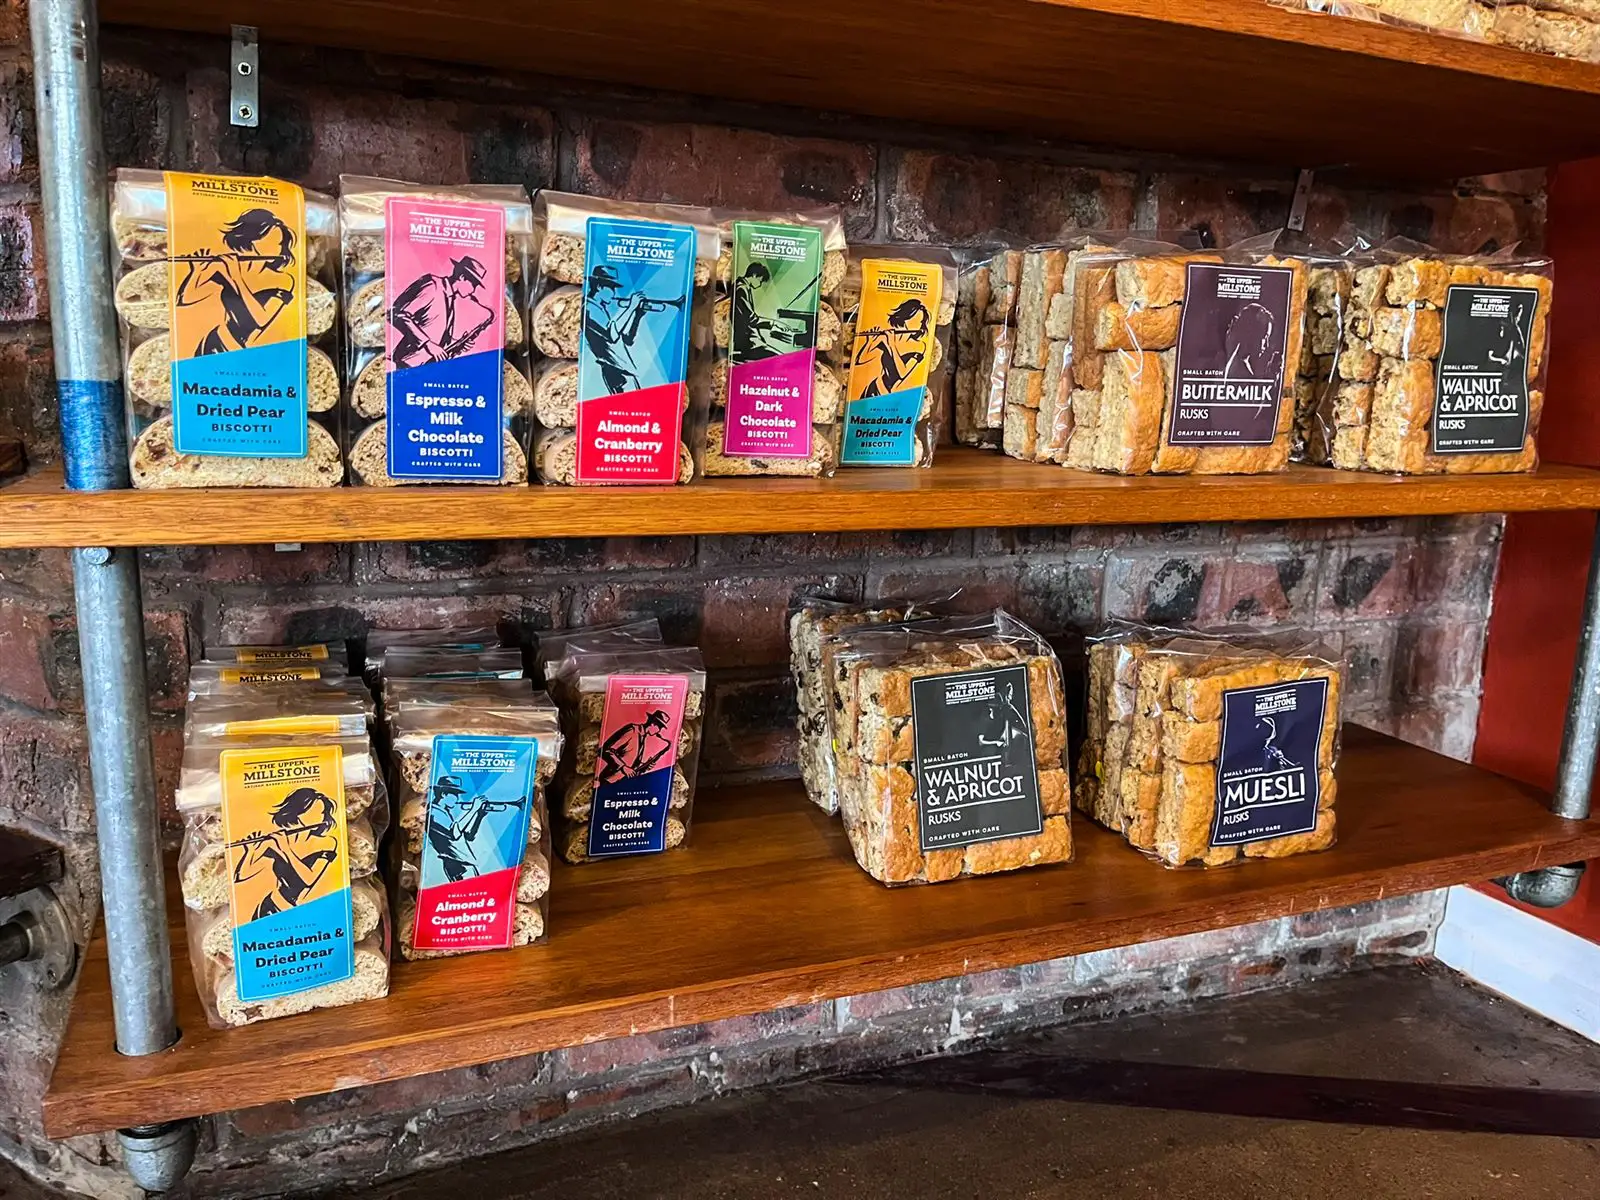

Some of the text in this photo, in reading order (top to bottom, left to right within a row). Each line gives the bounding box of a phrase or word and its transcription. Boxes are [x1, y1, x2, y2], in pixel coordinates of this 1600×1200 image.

[192, 181, 278, 197] MILLSTONE
[424, 217, 471, 228] THE UPPER
[410, 223, 484, 240] MILLSTONE
[621, 238, 662, 248] THE UPPER
[776, 238, 796, 246] UPPER
[607, 244, 674, 258] MILLSTONE
[750, 242, 806, 256] MILLSTONE
[878, 278, 928, 290] MILLSTONE
[1218, 282, 1260, 293] MILLSTONE
[1470, 303, 1510, 312] MILLSTONE
[182, 382, 297, 398] Macadamia &
[740, 384, 800, 398] Hazelnut &
[1182, 384, 1272, 401] BUTTERMILK
[1442, 378, 1502, 394] WALNUT
[406, 392, 486, 408] Espresso &
[756, 400, 782, 412] Dark
[1440, 394, 1518, 412] & APRICOT
[197, 403, 286, 418] Dried Pear
[1180, 409, 1209, 420] RUSKS
[430, 412, 464, 425] Milk
[740, 415, 796, 428] Chocolate
[850, 416, 913, 425] Macadamia &
[1439, 420, 1466, 430] RUSKS
[212, 423, 272, 433] BISCOTTI
[597, 420, 661, 434] Almond &
[856, 429, 904, 438] Dried Pear
[408, 428, 484, 444] Chocolate
[748, 430, 788, 439] BISCOTTI
[594, 438, 663, 453] Cranberry
[420, 448, 472, 457] BISCOTTI
[604, 454, 652, 463] BISCOTTI
[240, 674, 302, 682] MILLSTONE
[621, 692, 673, 700] MILLSTONE
[946, 686, 995, 699] MILLSTONE
[1256, 697, 1296, 710] MILLSTONE
[278, 760, 304, 768] UPPER
[452, 758, 516, 766] MILLSTONE
[924, 752, 968, 764] SMALL BATCH
[244, 766, 320, 782] MILLSTONE
[924, 762, 1002, 789] WALNUT
[1223, 770, 1243, 778] SMALL
[927, 776, 1024, 806] & APRICOT
[1224, 773, 1306, 809] MUESLI
[604, 796, 659, 810] Espresso &
[618, 810, 641, 819] Milk
[928, 810, 962, 826] RUSKS
[1223, 810, 1250, 826] RUSKS
[602, 820, 652, 832] Chocolate
[1220, 830, 1247, 840] CRAFTED
[1266, 824, 1281, 832] CARE
[609, 832, 645, 840] BISCOTTI
[929, 833, 960, 842] CRAFTED
[982, 826, 1000, 834] CARE
[436, 898, 496, 912] Almond &
[431, 912, 497, 926] Cranberry
[440, 924, 486, 936] BISCOTTI
[242, 928, 345, 953] Macadamia &
[256, 948, 335, 968] Dried Pear
[270, 962, 323, 978] BISCOTTI
